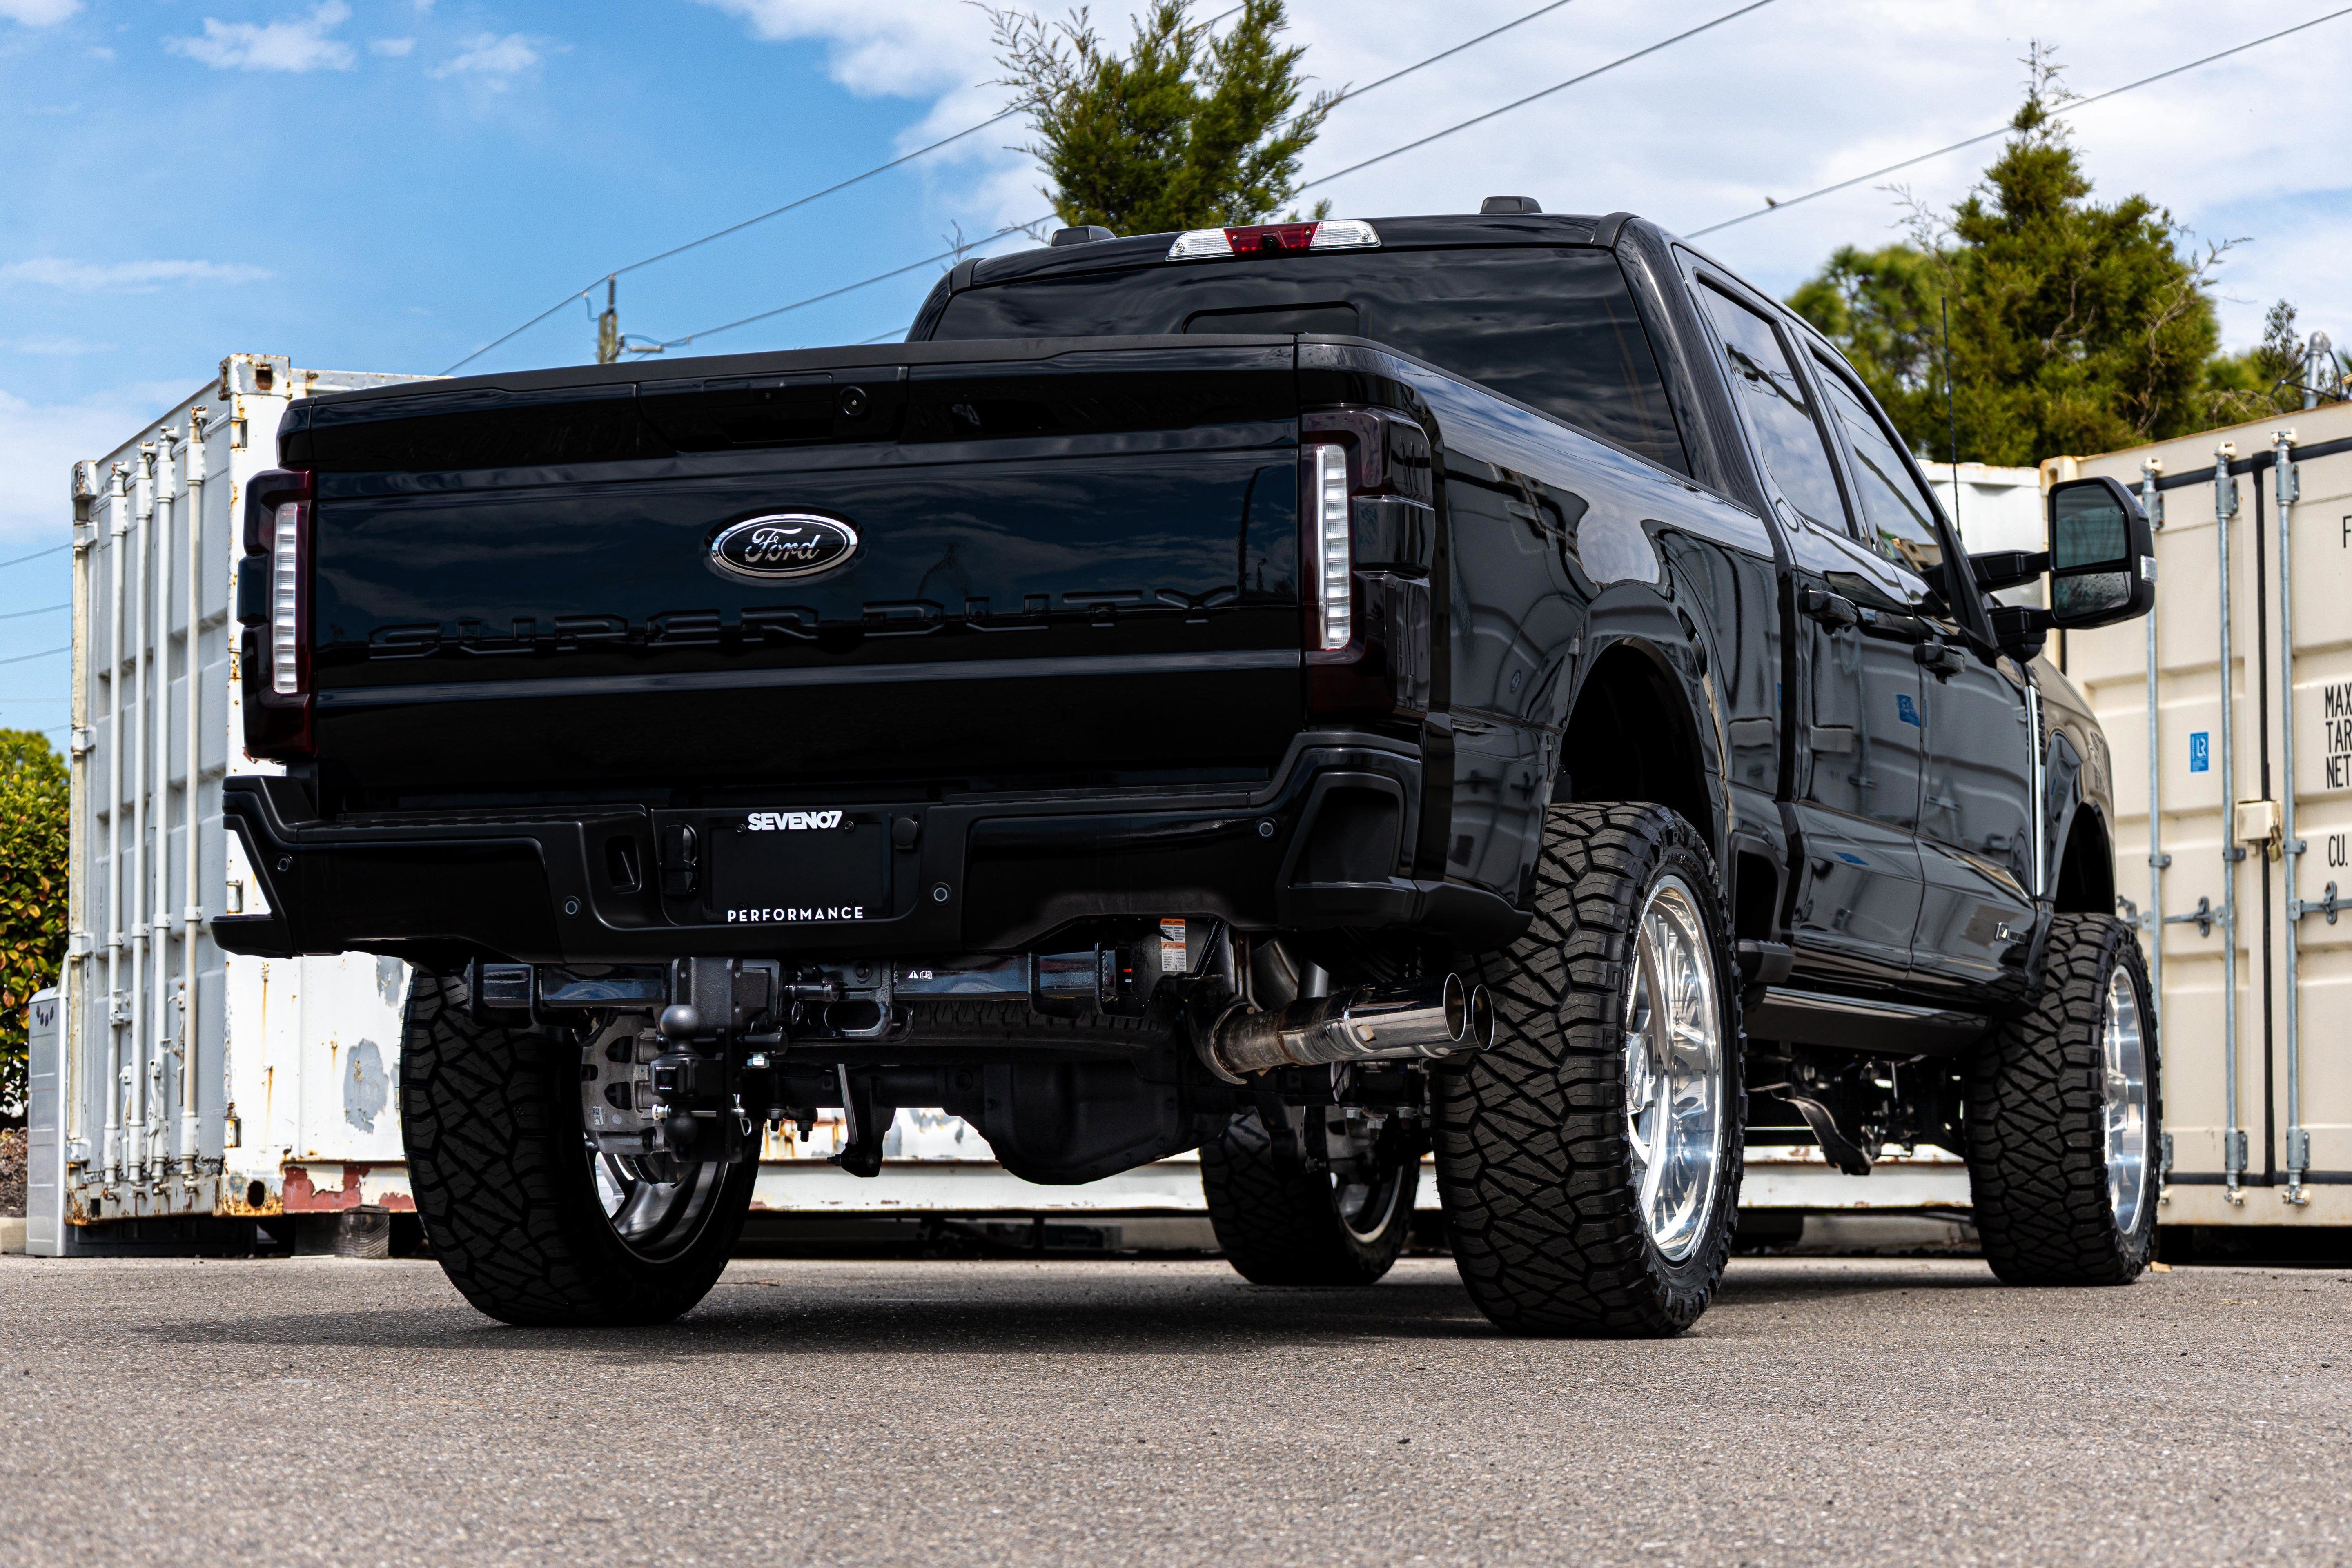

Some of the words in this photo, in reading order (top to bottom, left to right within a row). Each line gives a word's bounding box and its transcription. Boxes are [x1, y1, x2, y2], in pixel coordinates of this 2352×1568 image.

[745, 528, 821, 562] Ford
[368, 605, 819, 659] SUPER
[862, 585, 1238, 637] DUTY
[2326, 754, 2351, 789] NET
[2329, 834, 2348, 868] CU.
[728, 906, 863, 922] PERFORMANCE
